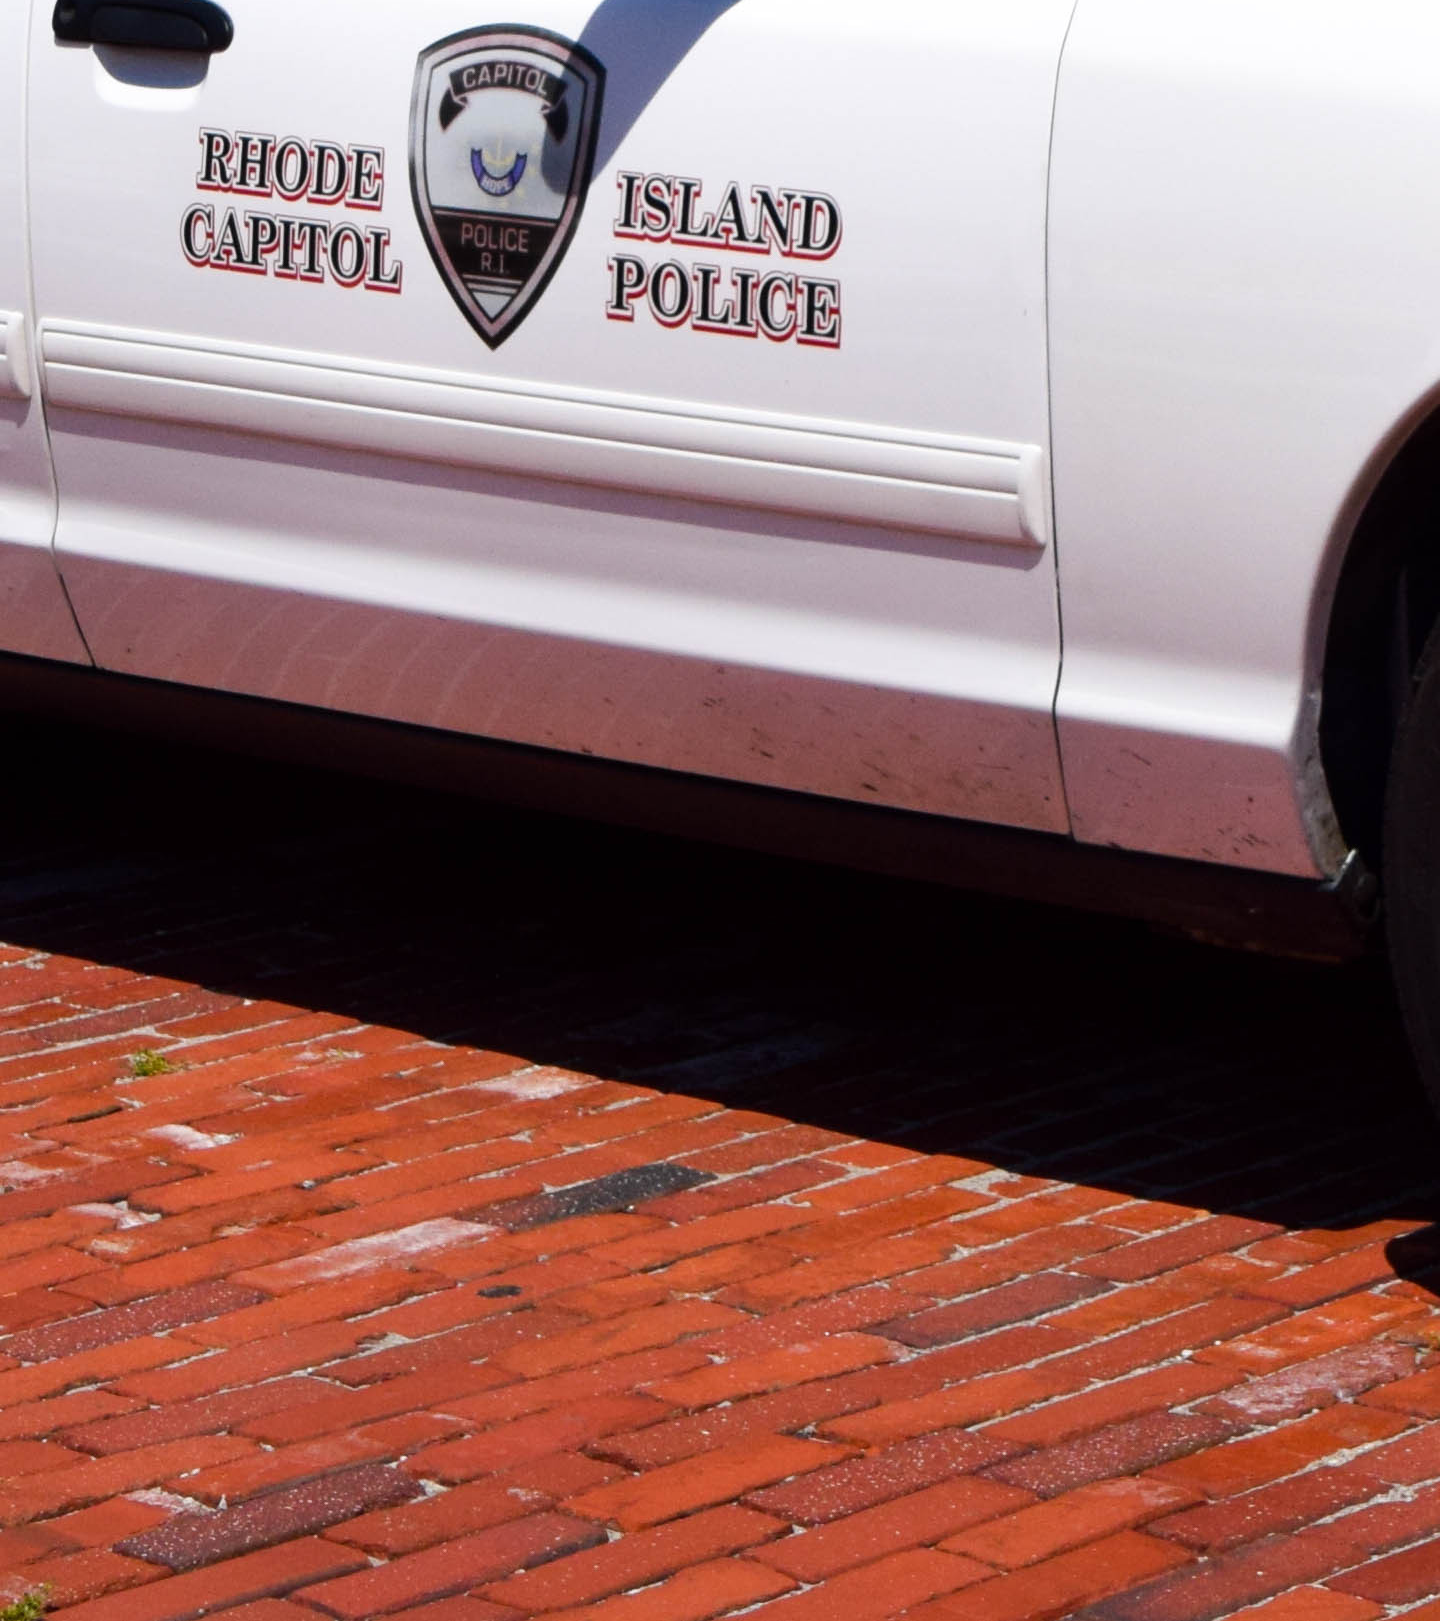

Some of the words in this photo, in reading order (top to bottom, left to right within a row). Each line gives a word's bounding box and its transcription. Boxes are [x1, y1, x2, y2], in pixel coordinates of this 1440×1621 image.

[462, 63, 548, 96] CAPITOL
[196, 127, 385, 212] RHODE
[180, 203, 403, 295] CAPITOL
[462, 223, 529, 253] POLICE
[613, 170, 843, 262] ISLAND
[606, 253, 842, 350] POLICE
